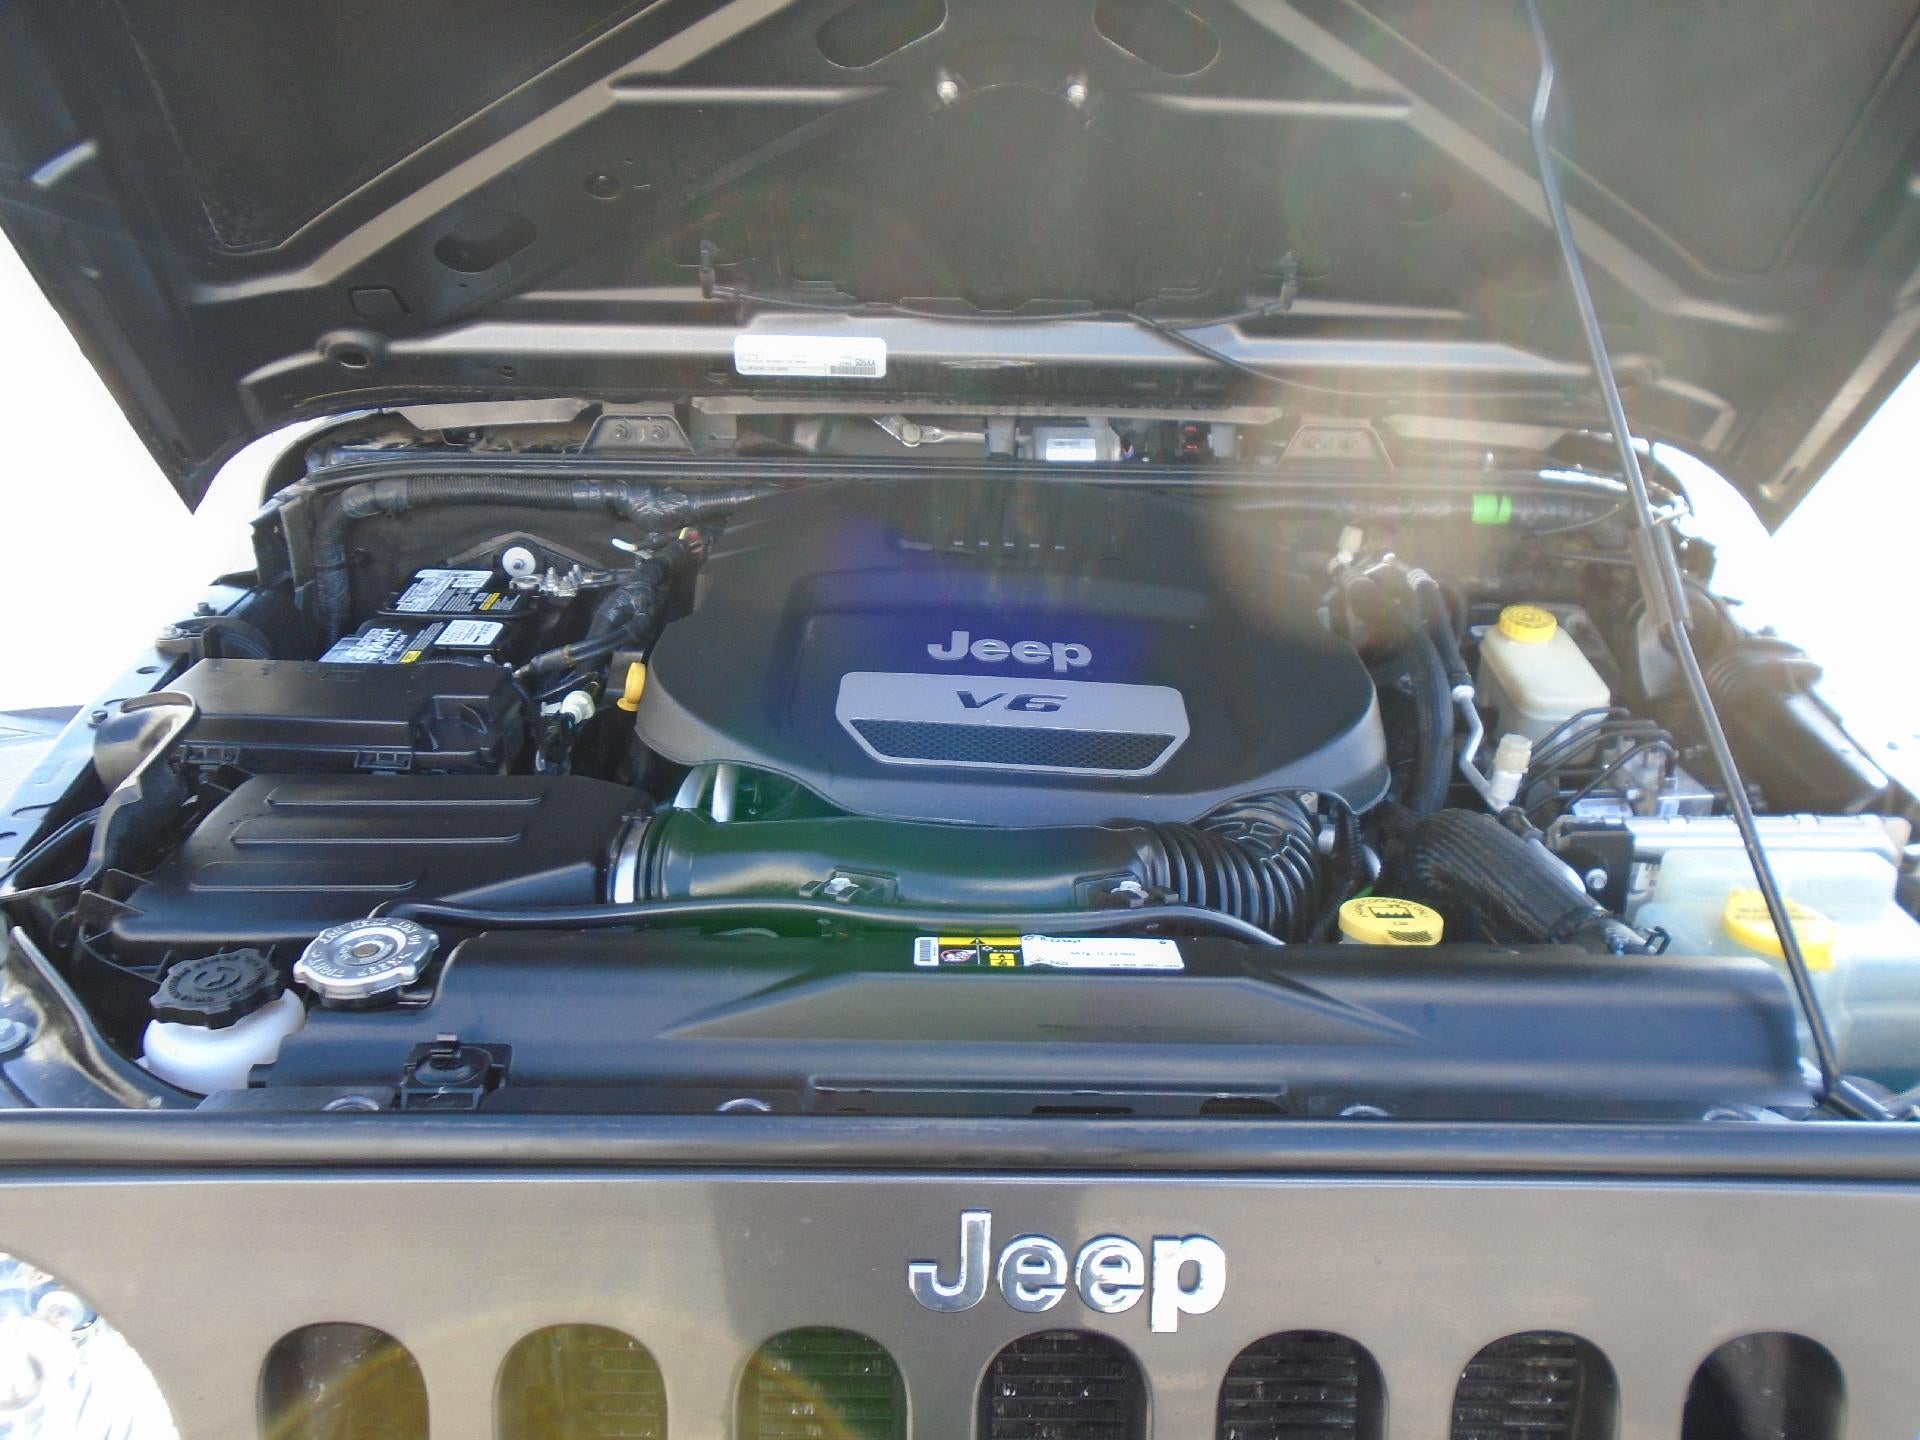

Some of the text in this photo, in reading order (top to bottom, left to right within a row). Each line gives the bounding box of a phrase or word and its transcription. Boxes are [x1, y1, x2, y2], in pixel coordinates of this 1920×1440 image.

[927, 630, 1092, 673] Jeep
[956, 690, 1067, 712] V6
[908, 1209, 1226, 1333] Jeep
